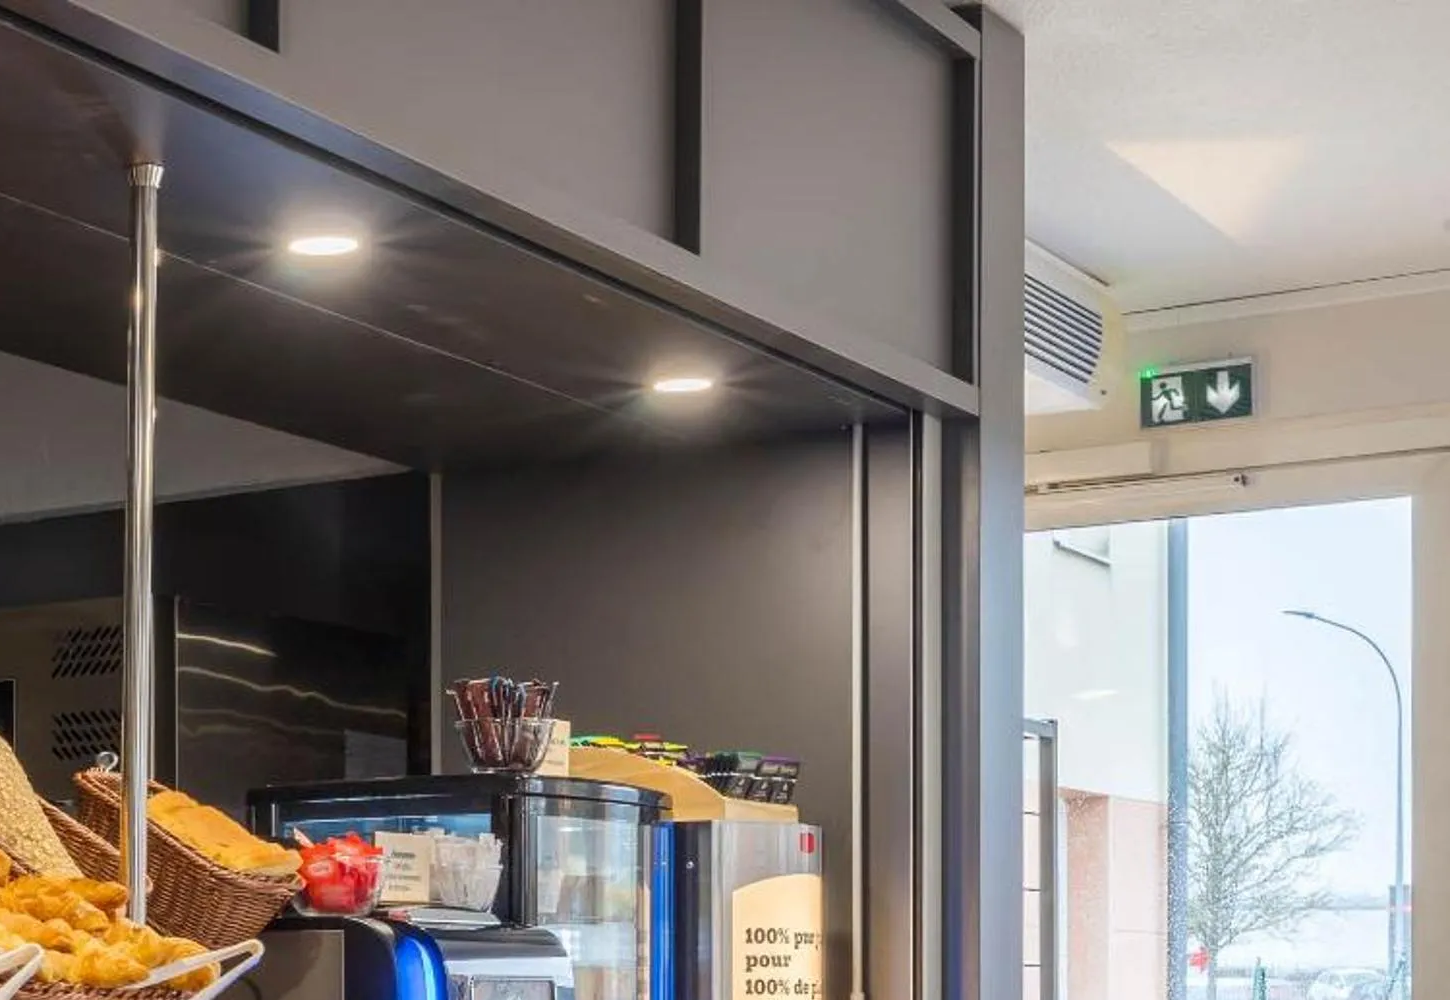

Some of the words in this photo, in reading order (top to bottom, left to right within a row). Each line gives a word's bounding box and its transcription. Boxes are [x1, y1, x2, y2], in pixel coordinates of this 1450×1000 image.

[745, 927, 790, 945] 100%
[745, 955, 791, 973] pour
[745, 979, 790, 995] 100%
